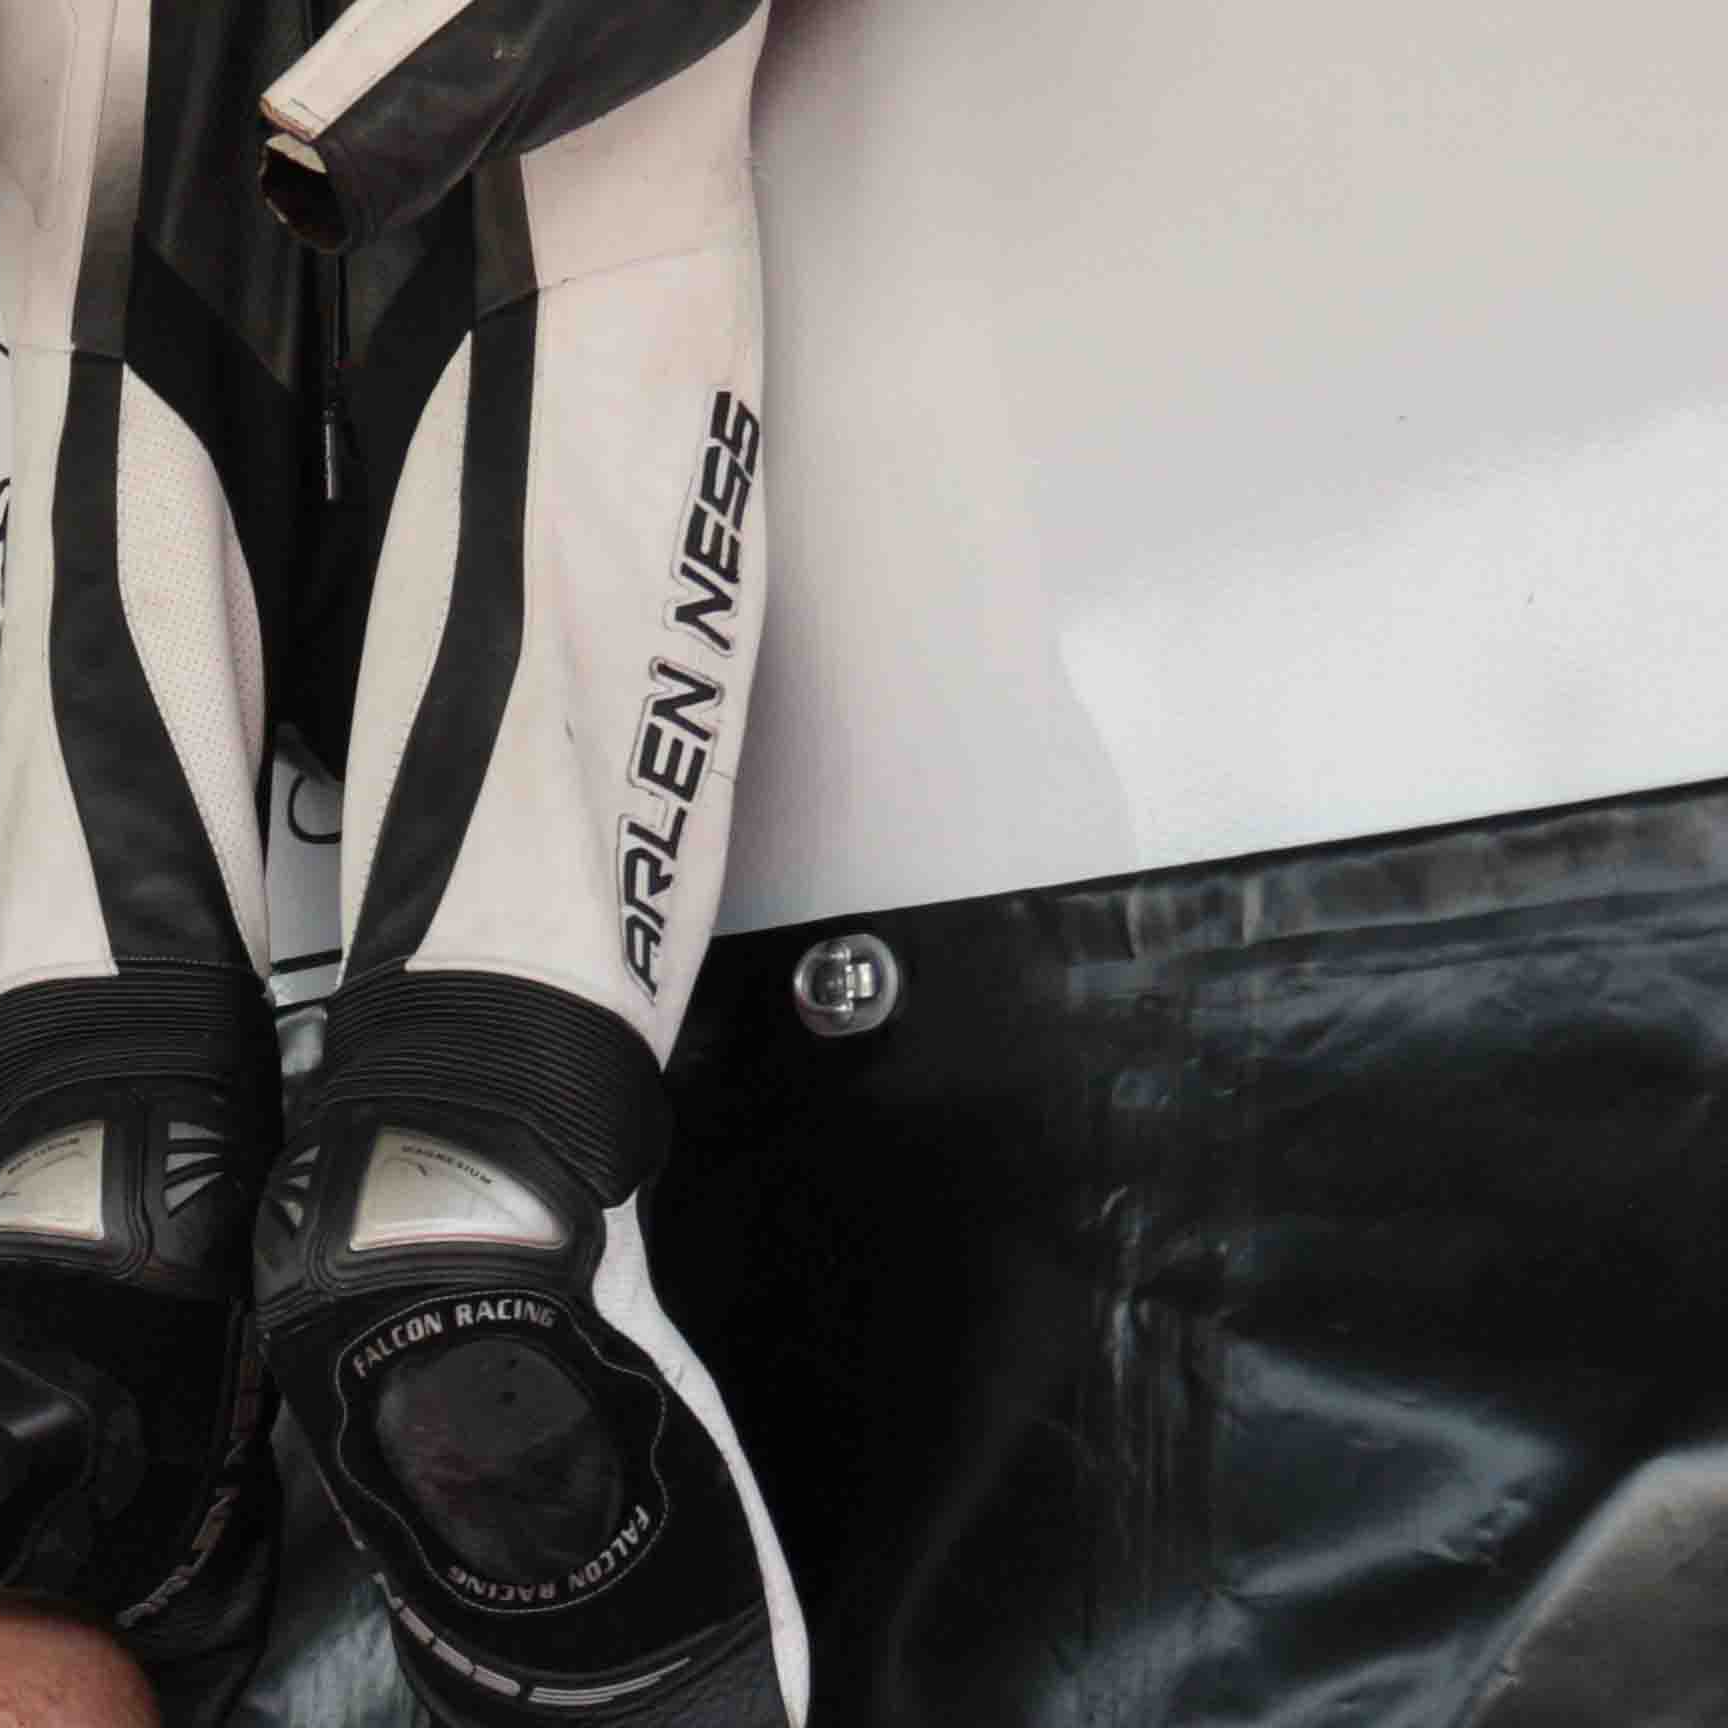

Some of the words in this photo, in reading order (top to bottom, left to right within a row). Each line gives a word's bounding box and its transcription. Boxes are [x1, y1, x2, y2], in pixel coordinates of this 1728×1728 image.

[623, 660, 720, 996] ARLEN
[674, 391, 760, 651] NESS
[352, 1311, 443, 1379] FALCON
[455, 1298, 557, 1330] RACING
[446, 1564, 557, 1602] RACING
[567, 1505, 651, 1583] FALCON
